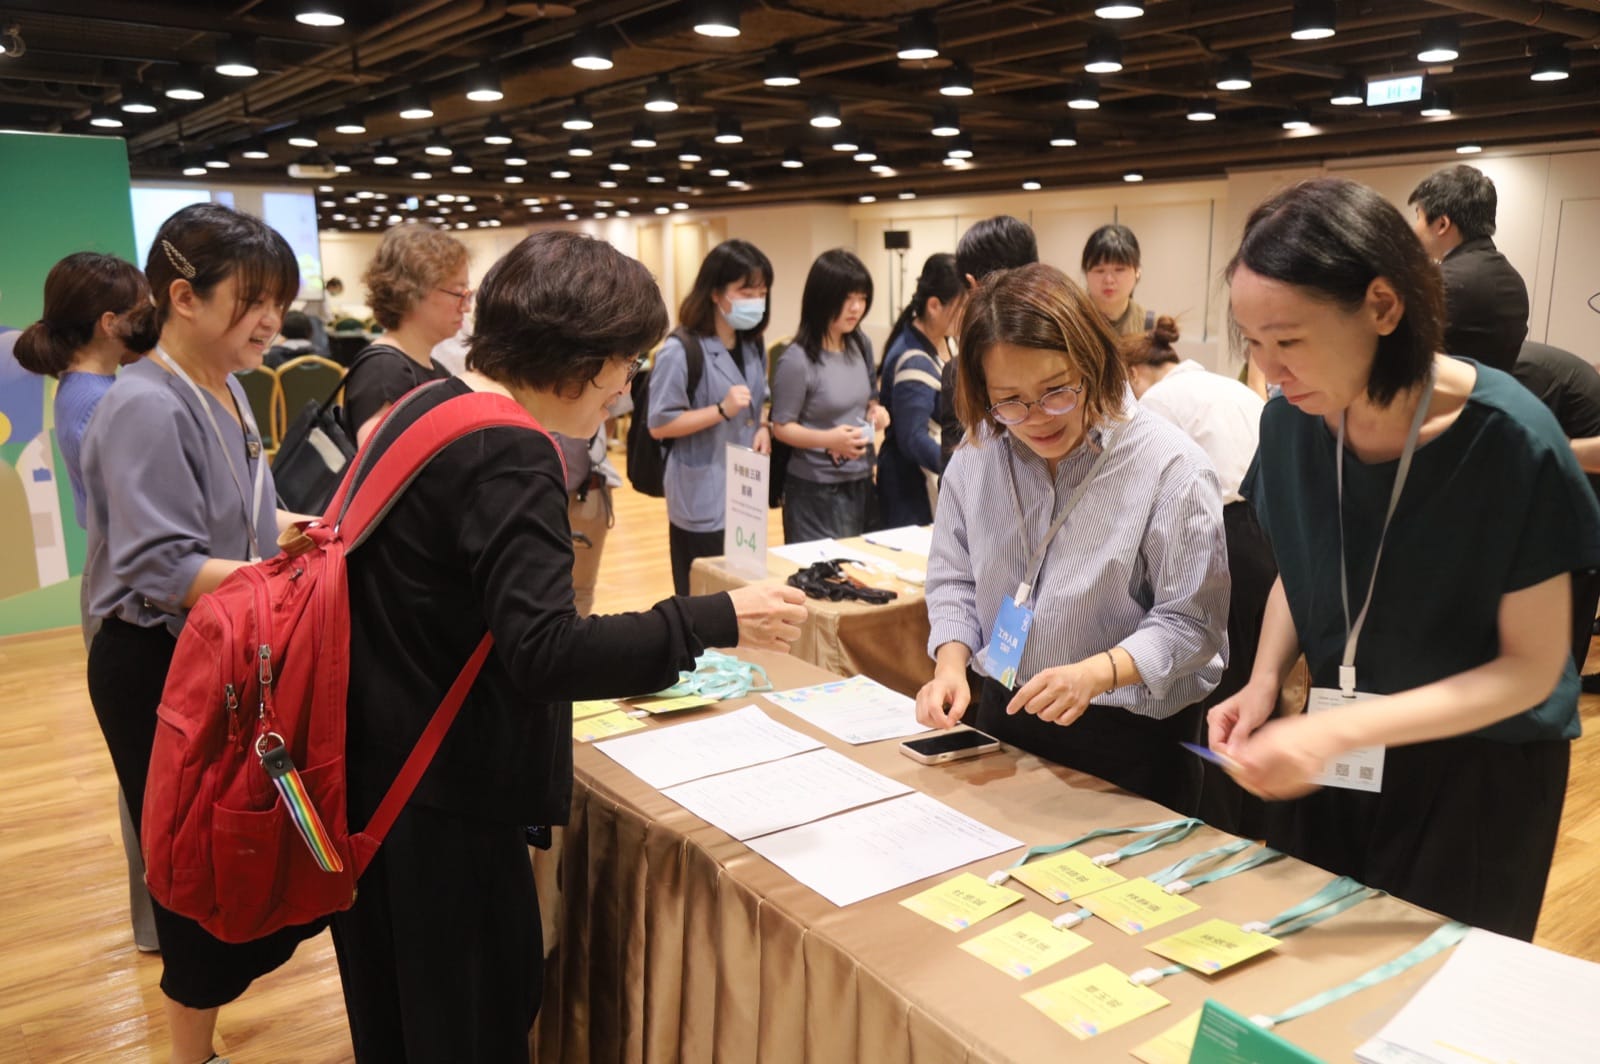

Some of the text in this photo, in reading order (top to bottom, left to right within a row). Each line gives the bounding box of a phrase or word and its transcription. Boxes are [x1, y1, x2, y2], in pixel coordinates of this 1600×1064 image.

[735, 526, 757, 552] 0-4
[997, 627, 1019, 649] 工作人員
